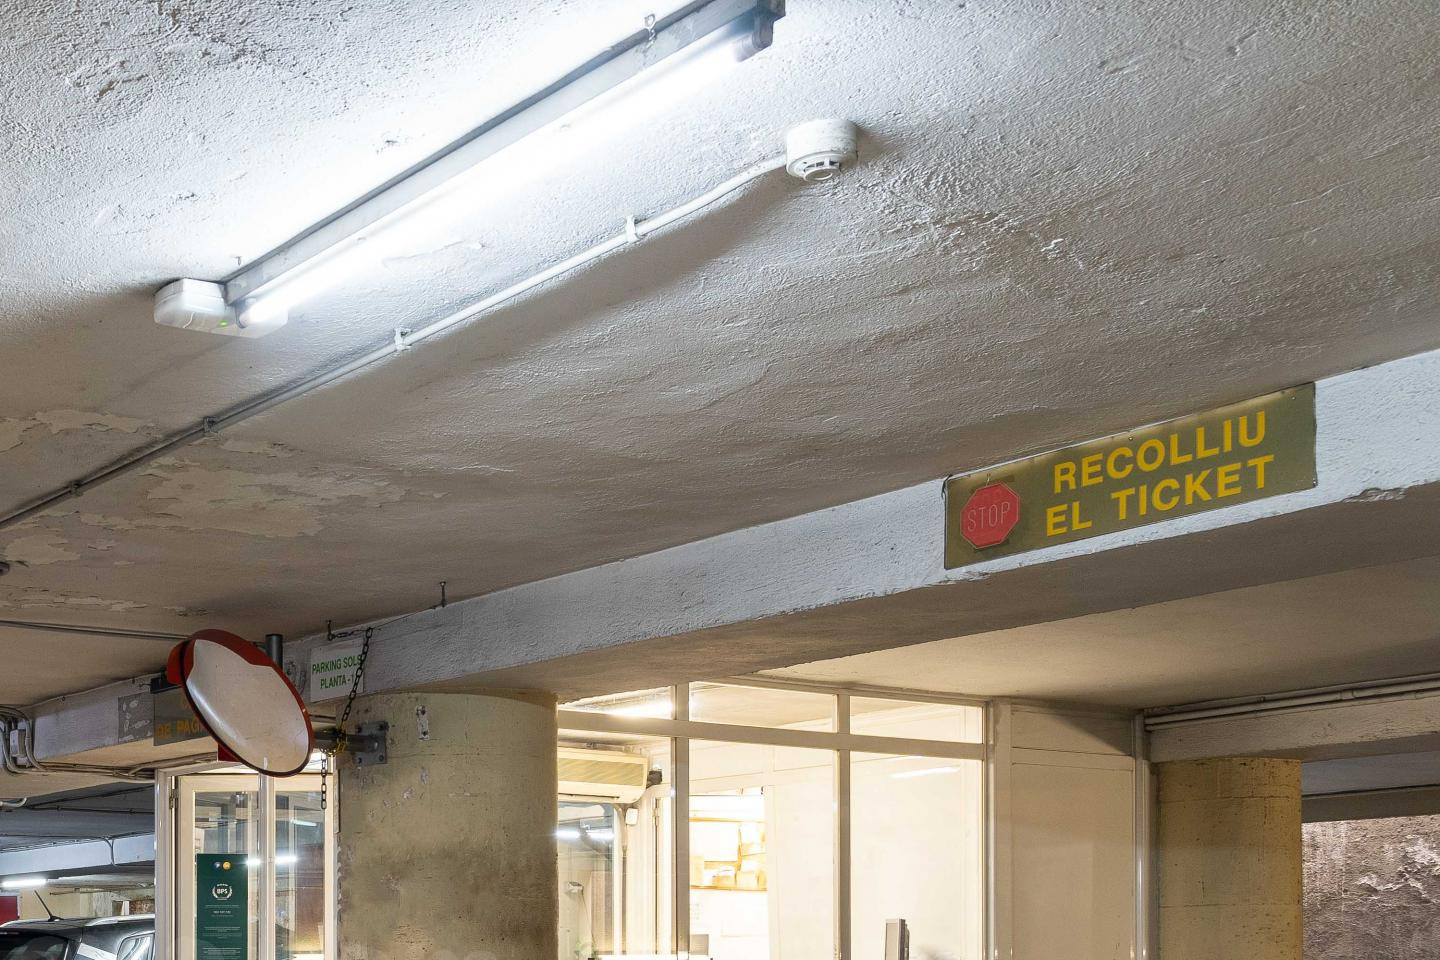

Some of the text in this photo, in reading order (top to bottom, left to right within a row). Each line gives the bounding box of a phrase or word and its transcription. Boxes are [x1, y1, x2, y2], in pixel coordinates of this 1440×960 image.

[1053, 410, 1266, 494] RECOLLIU
[1046, 454, 1275, 537] EL TICKET
[967, 501, 1011, 532] STOP
[312, 658, 342, 675] PARKING
[320, 674, 347, 689] PLANTA
